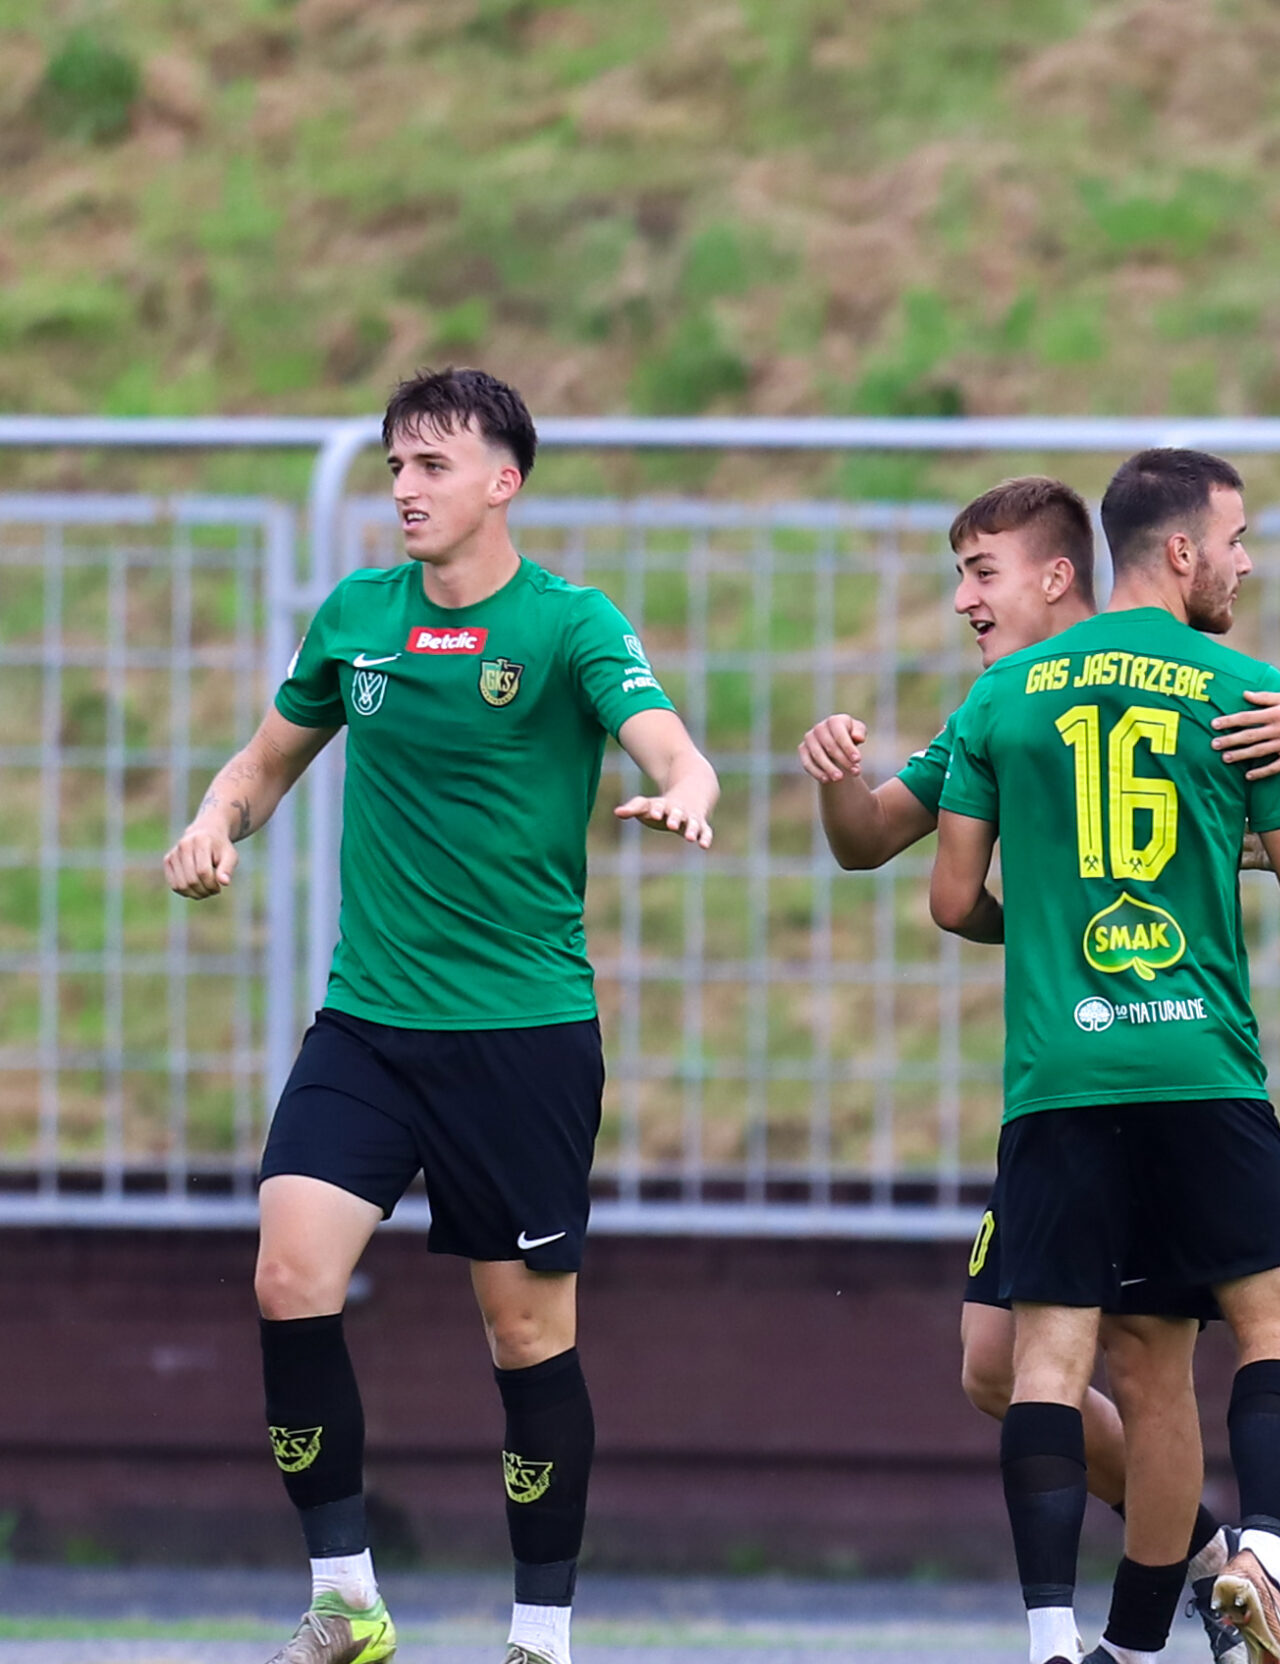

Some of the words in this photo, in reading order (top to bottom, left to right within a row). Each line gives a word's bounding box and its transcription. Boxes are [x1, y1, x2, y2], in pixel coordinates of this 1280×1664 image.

[416, 631, 478, 650] Betclic
[486, 669, 515, 692] GKS
[1025, 658, 1071, 694] GKS
[1054, 704, 1180, 881] 16
[1094, 922, 1171, 952] SMAK
[1129, 998, 1207, 1024] NATURALNE
